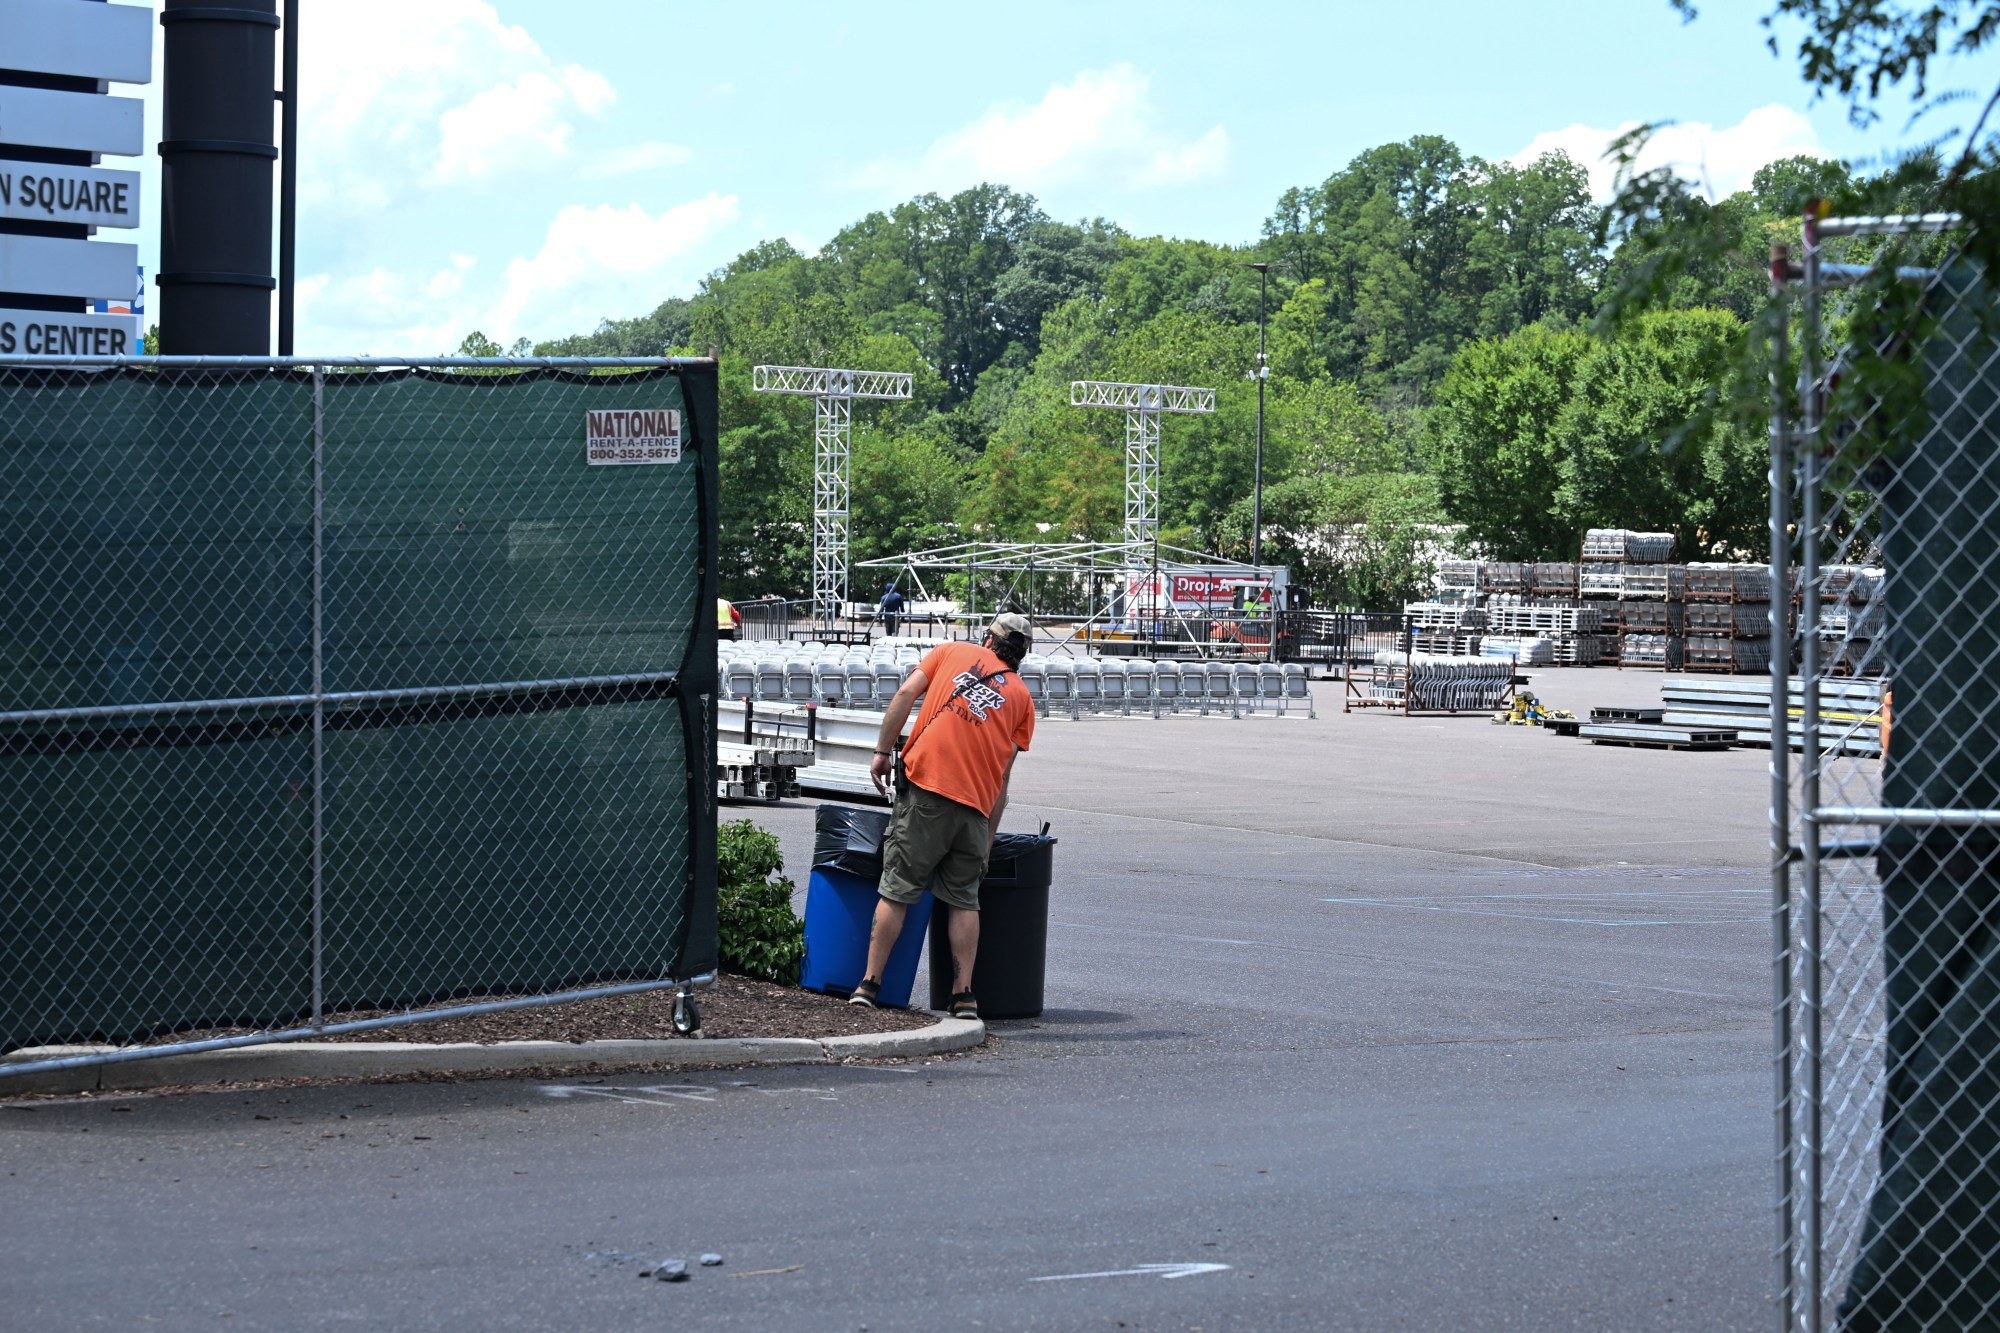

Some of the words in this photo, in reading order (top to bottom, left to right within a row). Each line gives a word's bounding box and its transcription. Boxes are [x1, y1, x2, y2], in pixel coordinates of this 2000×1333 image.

[19, 175, 129, 215] SQUARE
[24, 323, 127, 356] CENTER
[589, 411, 678, 438] NATIONAL
[590, 438, 678, 448] RENT-A-FENCE
[590, 448, 678, 459] 800-352-5675
[953, 672, 1005, 709] MUSIK
